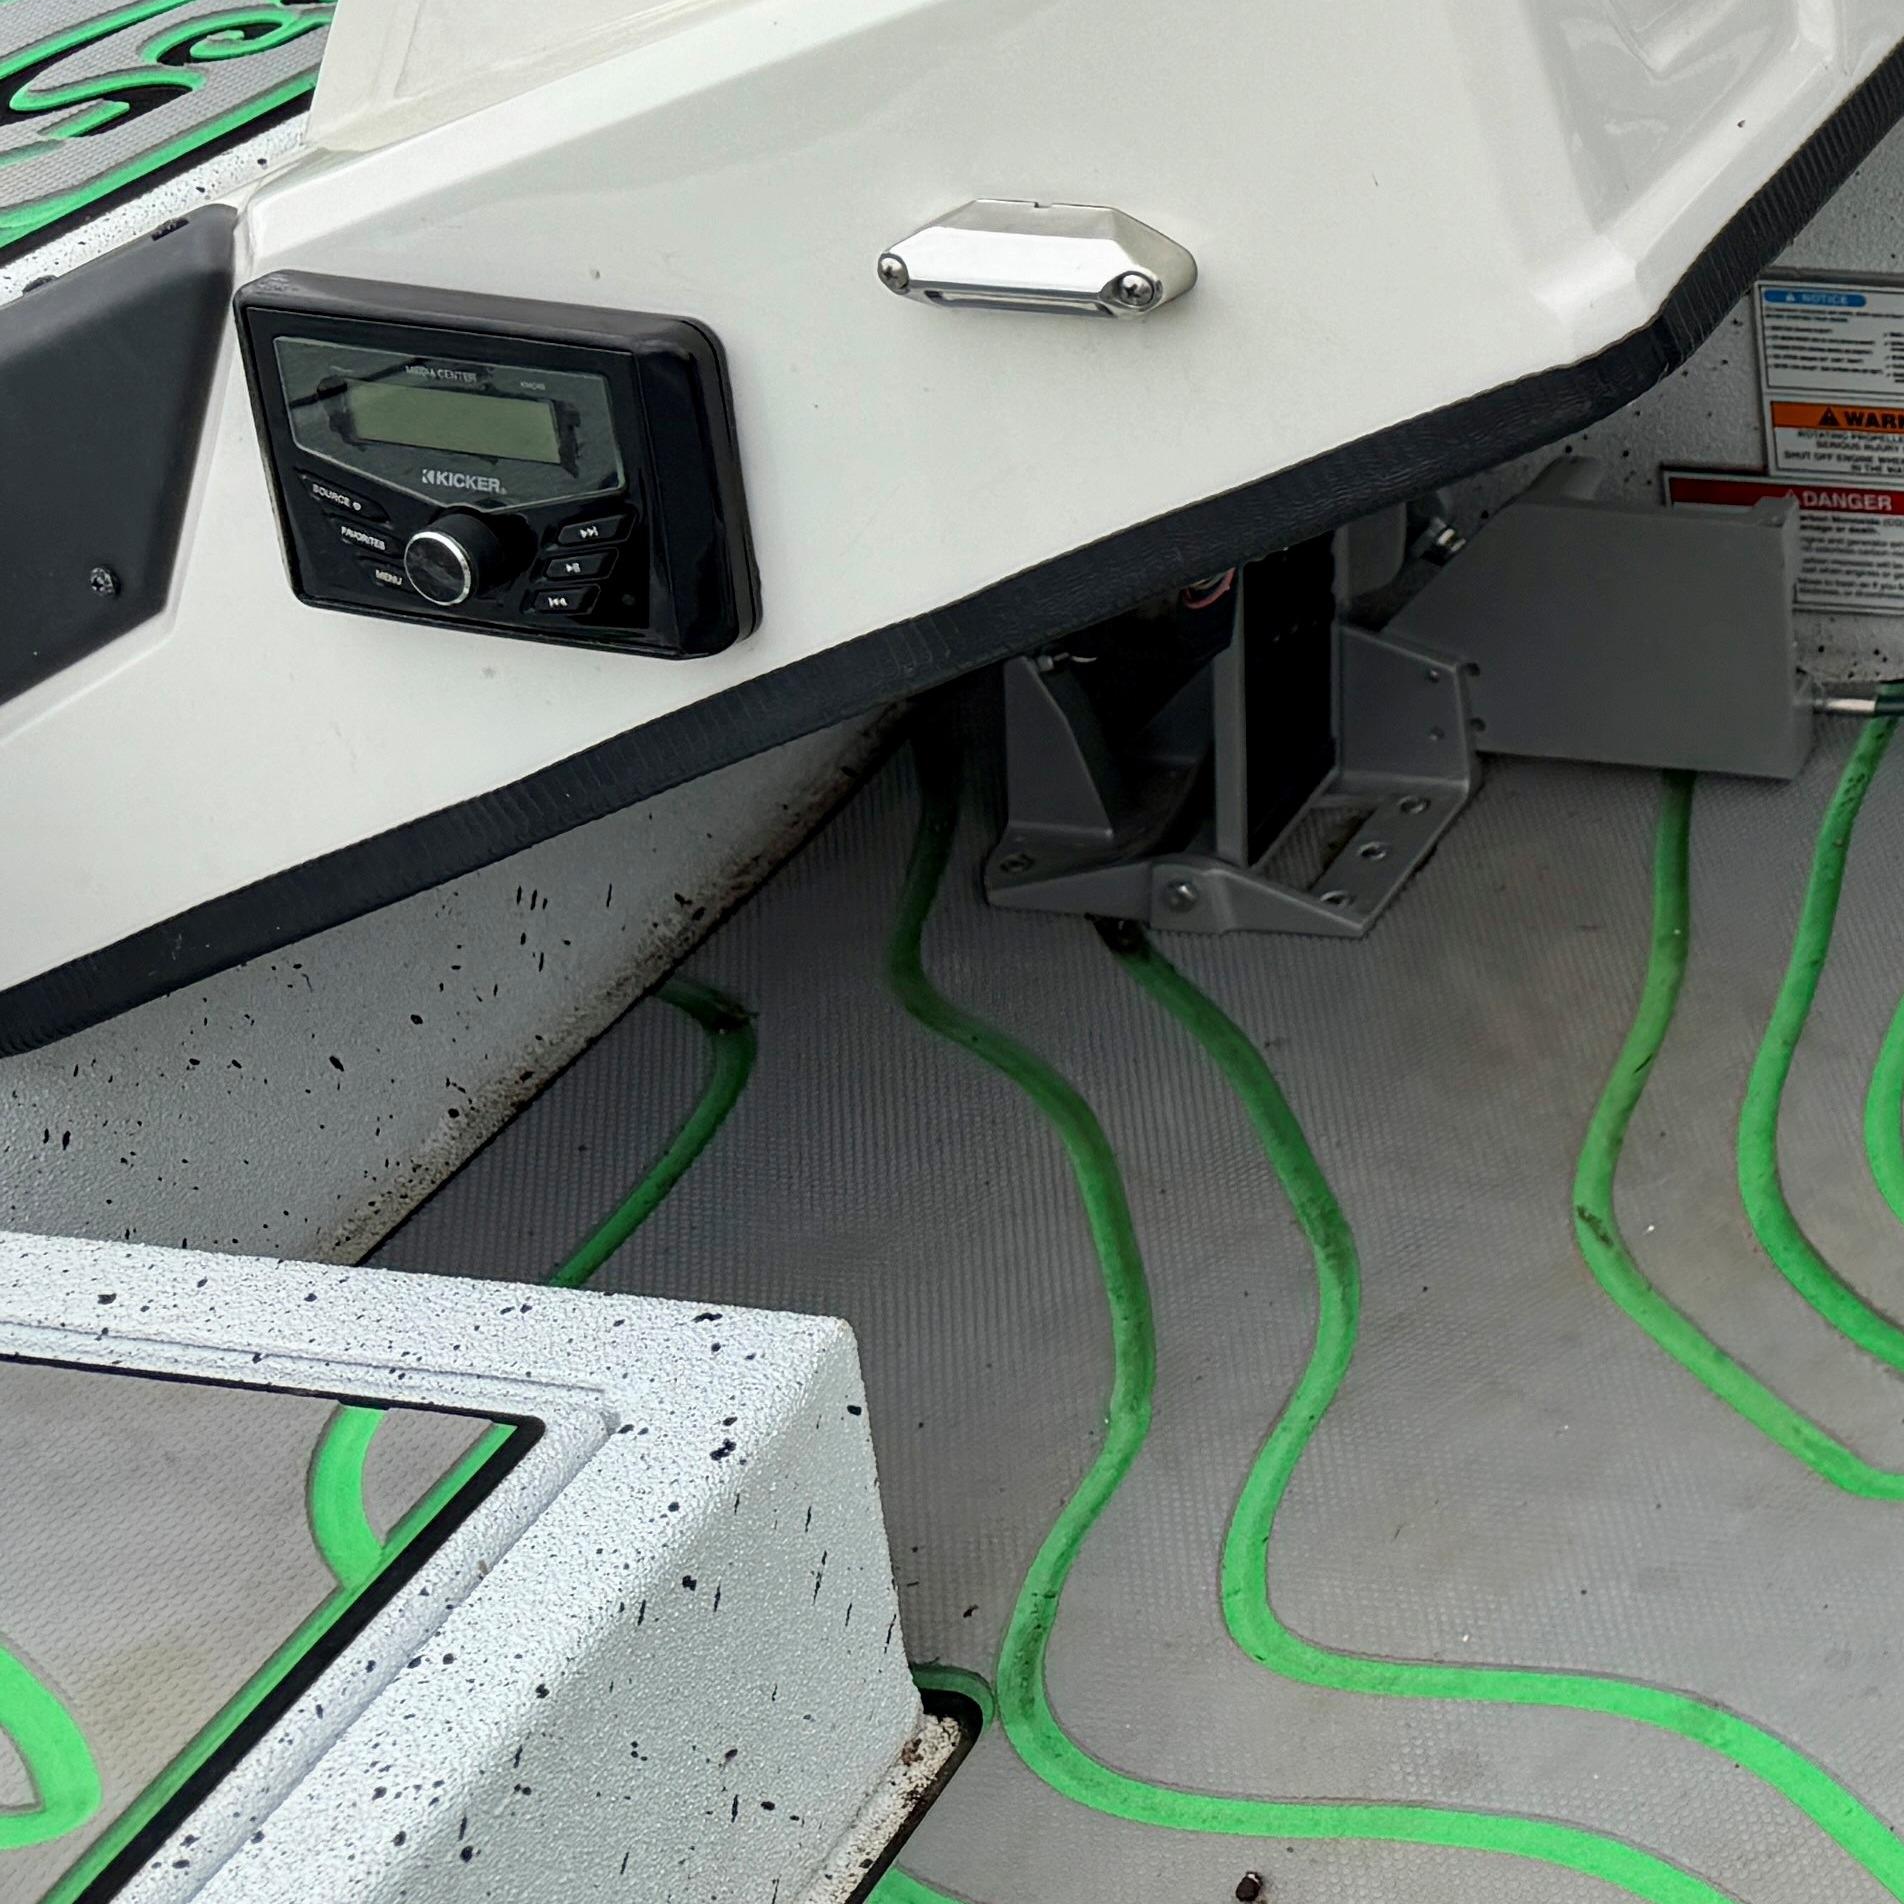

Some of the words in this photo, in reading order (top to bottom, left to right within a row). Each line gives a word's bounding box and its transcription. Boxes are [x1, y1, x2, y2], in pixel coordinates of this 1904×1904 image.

[1802, 294, 1849, 304] NOTICE
[437, 367, 478, 383] CENTER
[1784, 451, 1810, 460] SHUT
[1815, 453, 1832, 462] OFF
[1864, 465, 1882, 473] THE
[436, 470, 501, 494] KICKER
[312, 483, 352, 509] SOURCE
[1802, 491, 1892, 511] DANGER
[341, 526, 386, 551] FAVORITES
[375, 569, 403, 586] MENU
